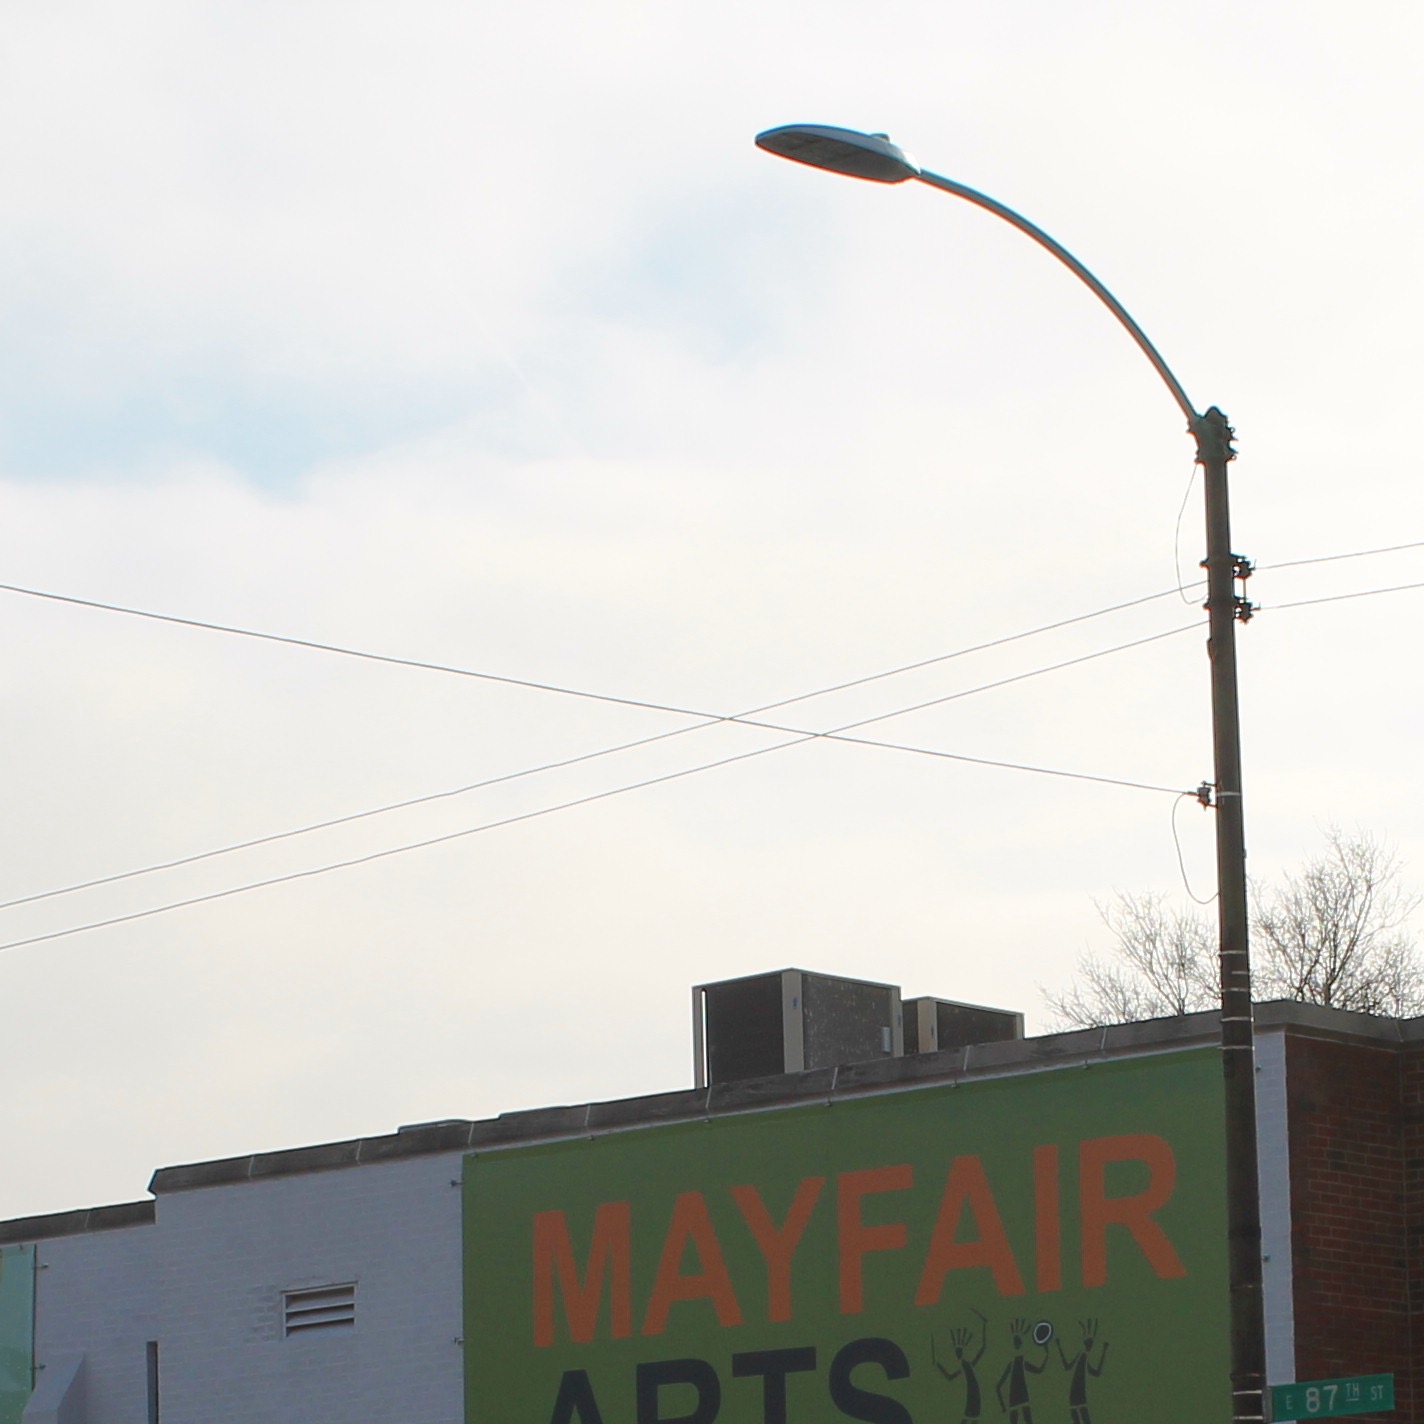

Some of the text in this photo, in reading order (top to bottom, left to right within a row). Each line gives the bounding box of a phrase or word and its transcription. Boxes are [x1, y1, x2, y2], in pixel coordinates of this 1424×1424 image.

[532, 1132, 1188, 1347] MAYFAIR
[1286, 1395, 1292, 1410] E
[1370, 1385, 1384, 1401] ST
